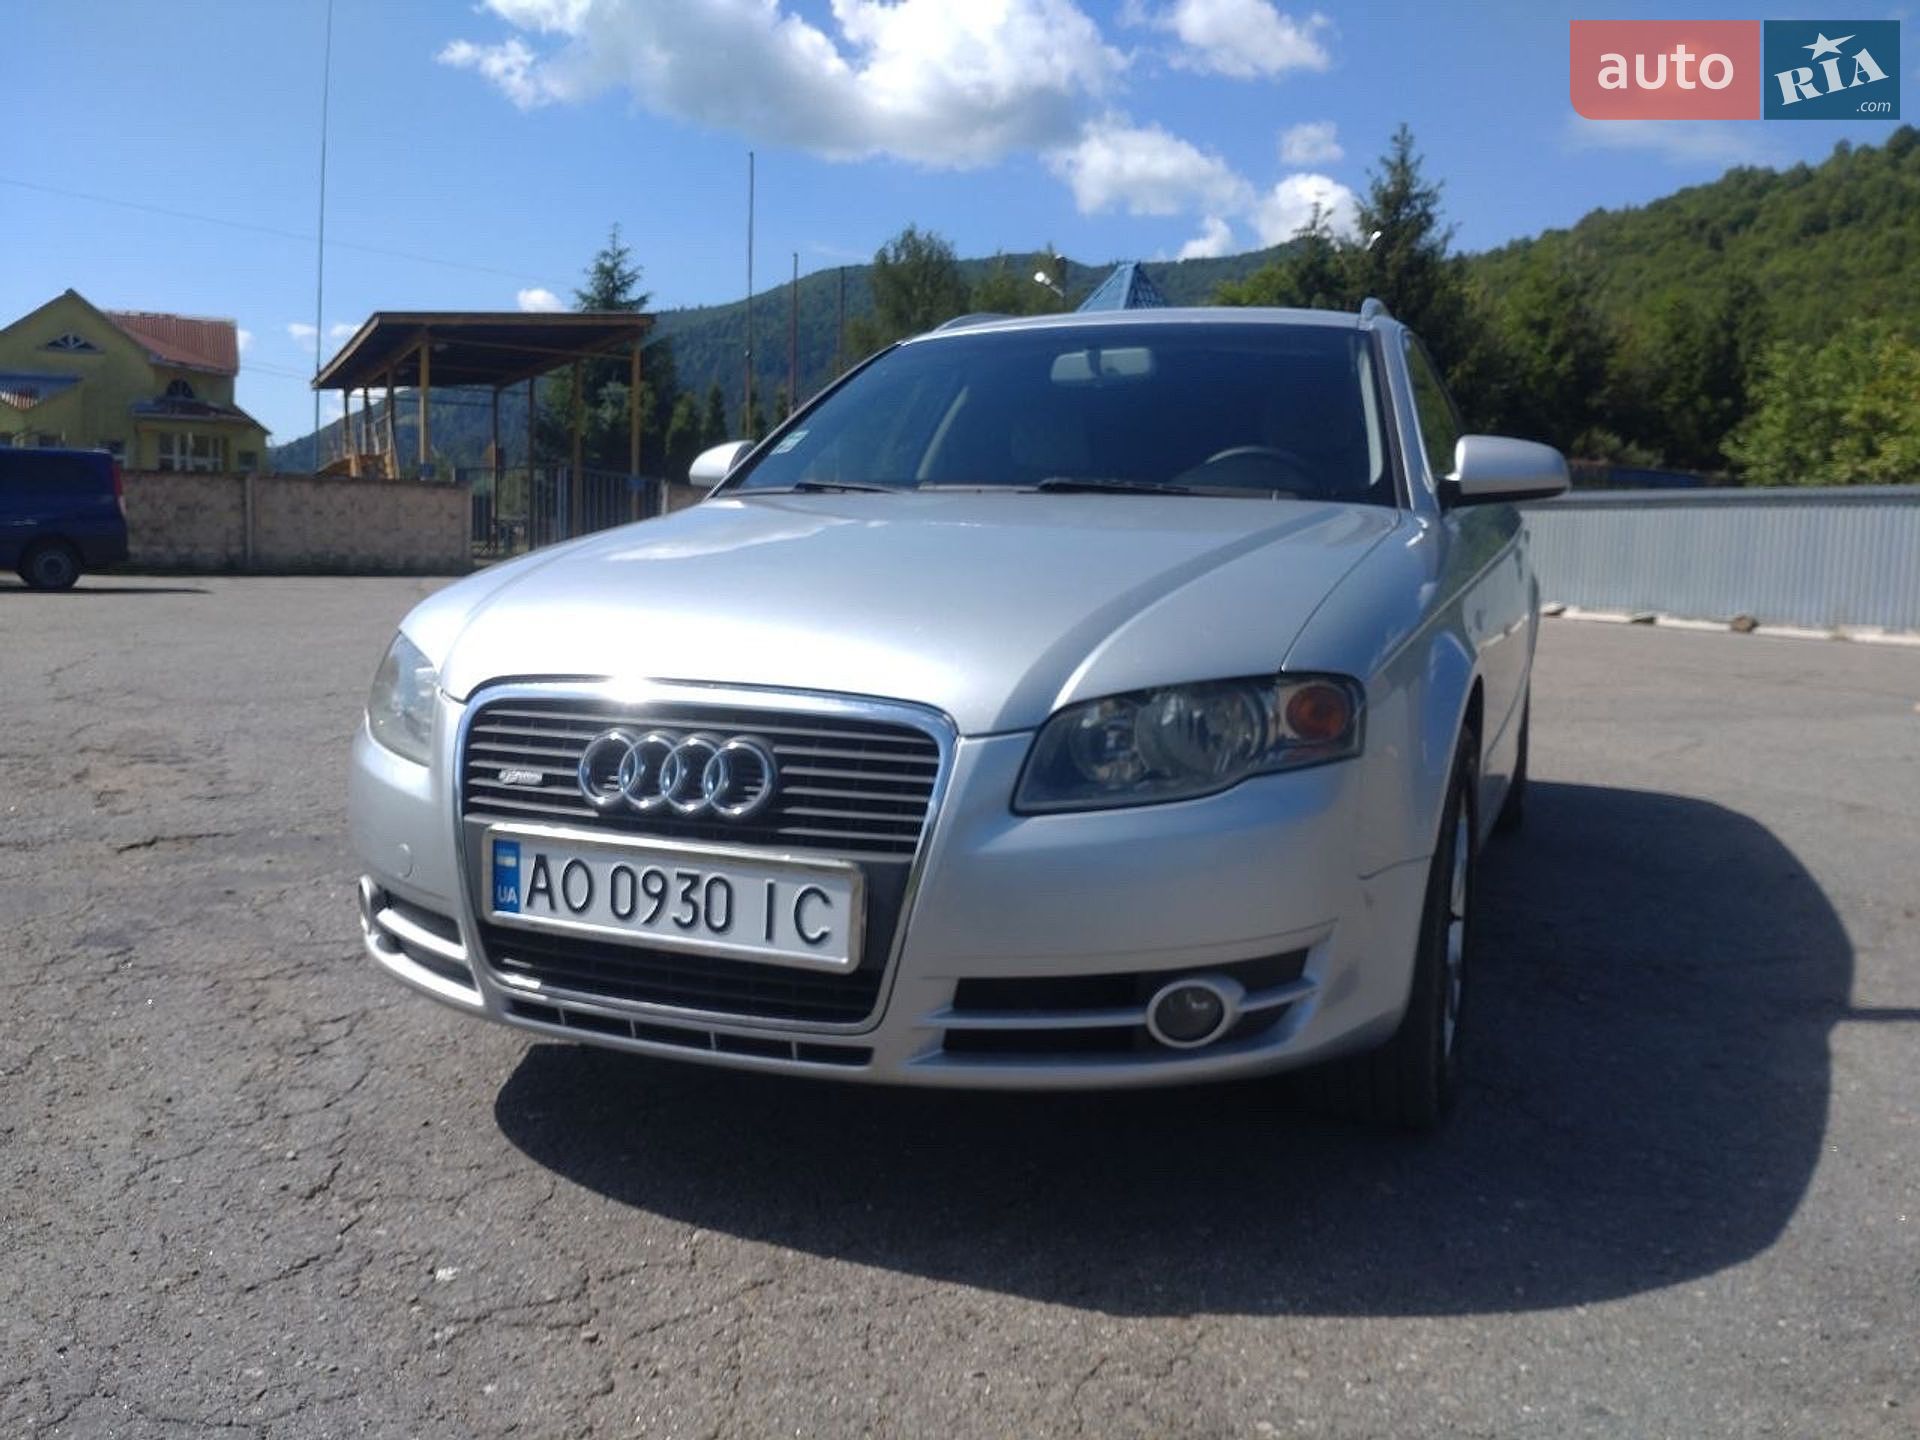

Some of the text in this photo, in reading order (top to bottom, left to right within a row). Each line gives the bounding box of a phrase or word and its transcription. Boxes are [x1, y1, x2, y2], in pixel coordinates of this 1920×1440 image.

[497, 885, 518, 904] UA
[526, 853, 832, 945] AO 0930 IC
